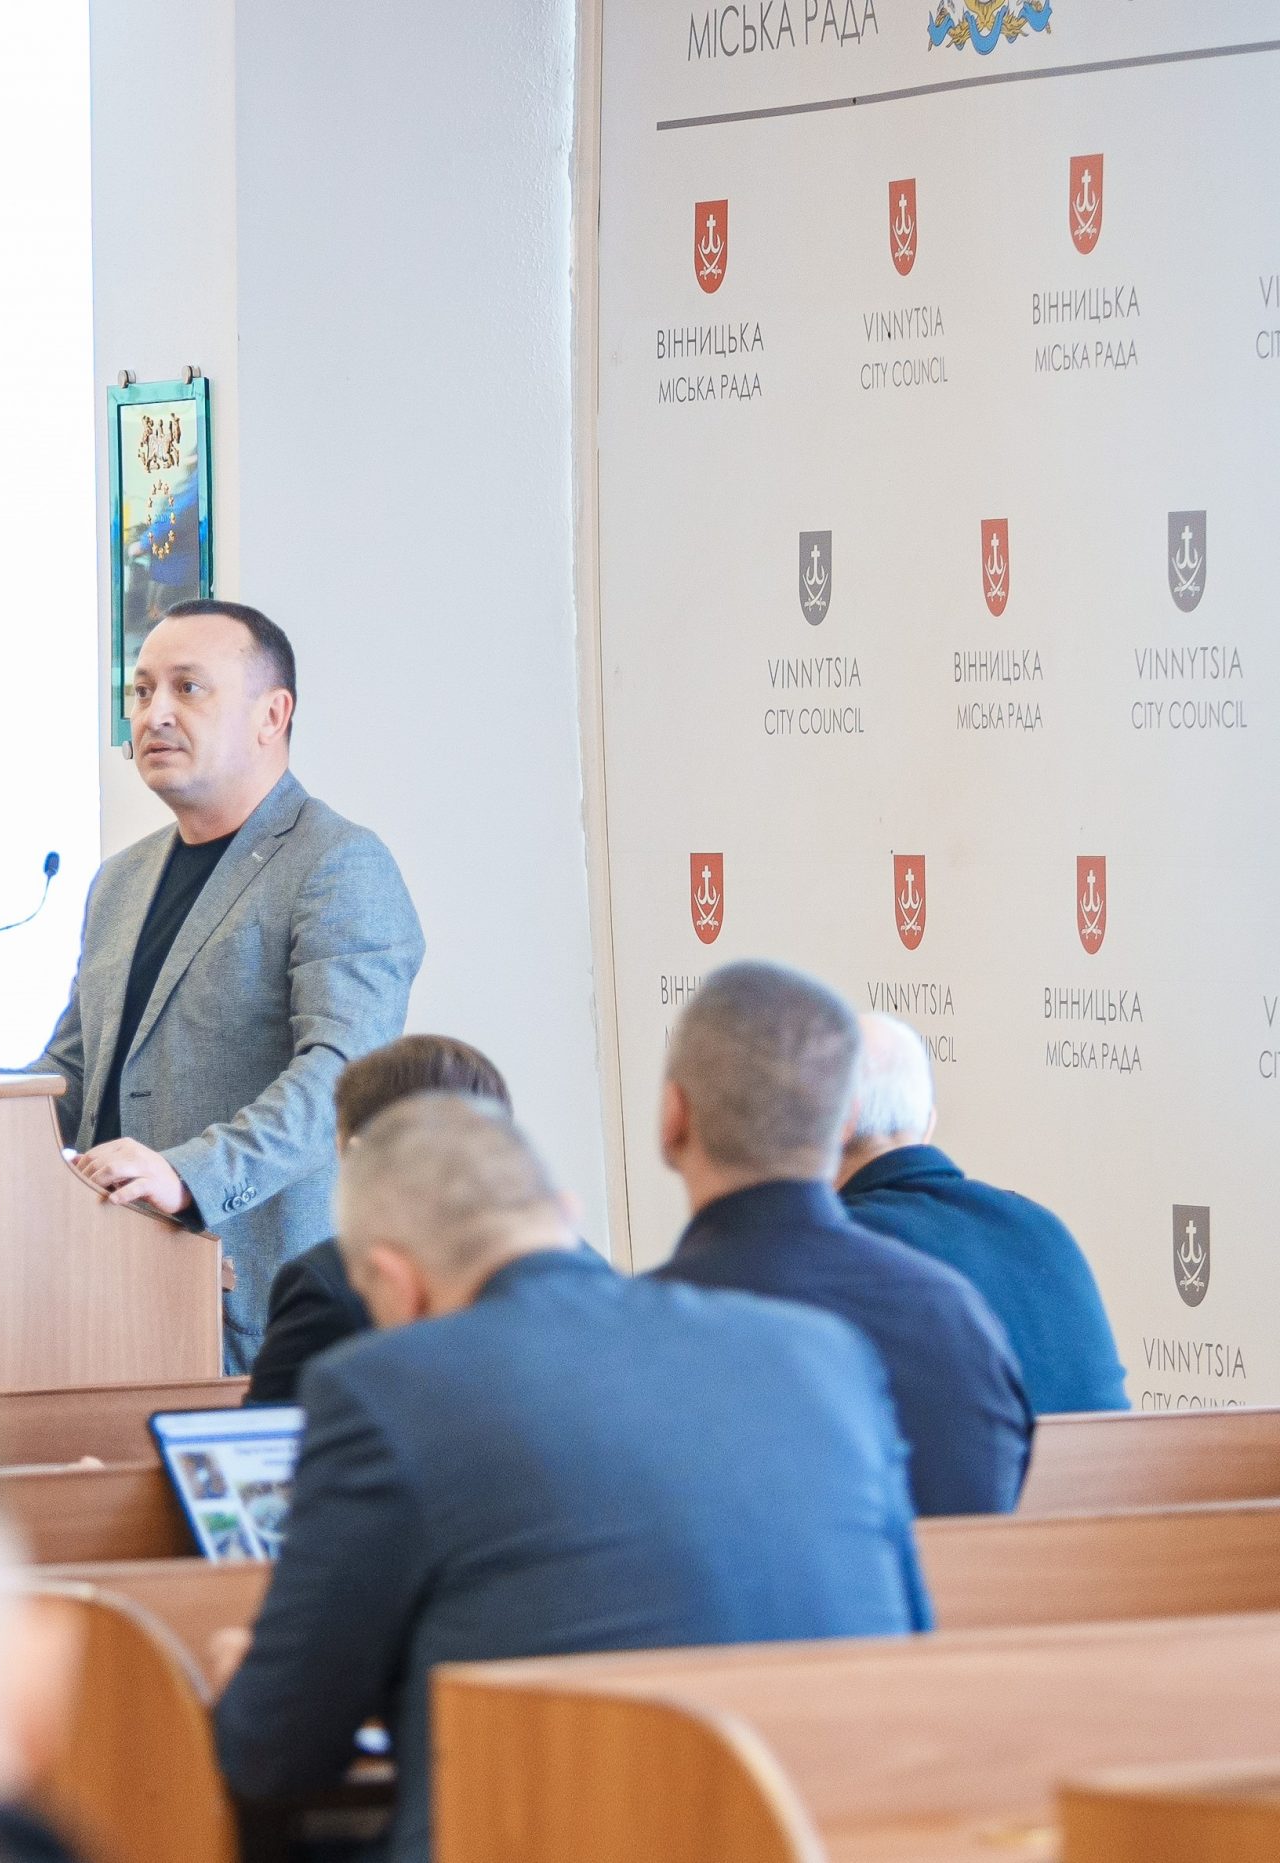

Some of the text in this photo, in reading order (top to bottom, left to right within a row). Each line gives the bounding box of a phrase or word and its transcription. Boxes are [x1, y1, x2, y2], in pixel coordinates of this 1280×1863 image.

[687, 0, 878, 61] МІСЬКА РАДА
[1032, 284, 1140, 324] ВІННИЦЬКА
[657, 322, 764, 359] ВІННИЦЬКА
[863, 305, 945, 343] VINNYTSIA
[1035, 338, 1138, 373] МІСЬКА РАДА
[659, 372, 762, 404] МІСЬКА РАДА
[860, 356, 948, 390] CITY COUNCIL
[768, 656, 861, 688] VINNYTSIA
[954, 650, 1043, 685] ВІННИЦЬКА
[1134, 646, 1244, 680] VINNYTSIA
[764, 707, 864, 735] CITY COUNCIL
[956, 702, 1043, 732] МІСЬКА РАДА
[1131, 700, 1248, 729] CITY COUNCIL
[867, 981, 955, 1015] VINNYTSIA
[1044, 987, 1143, 1025] ВІННИЦЬКА
[1046, 1040, 1142, 1074] МІСЬКА РАДА
[1143, 1337, 1246, 1379] VINNYTSIA
